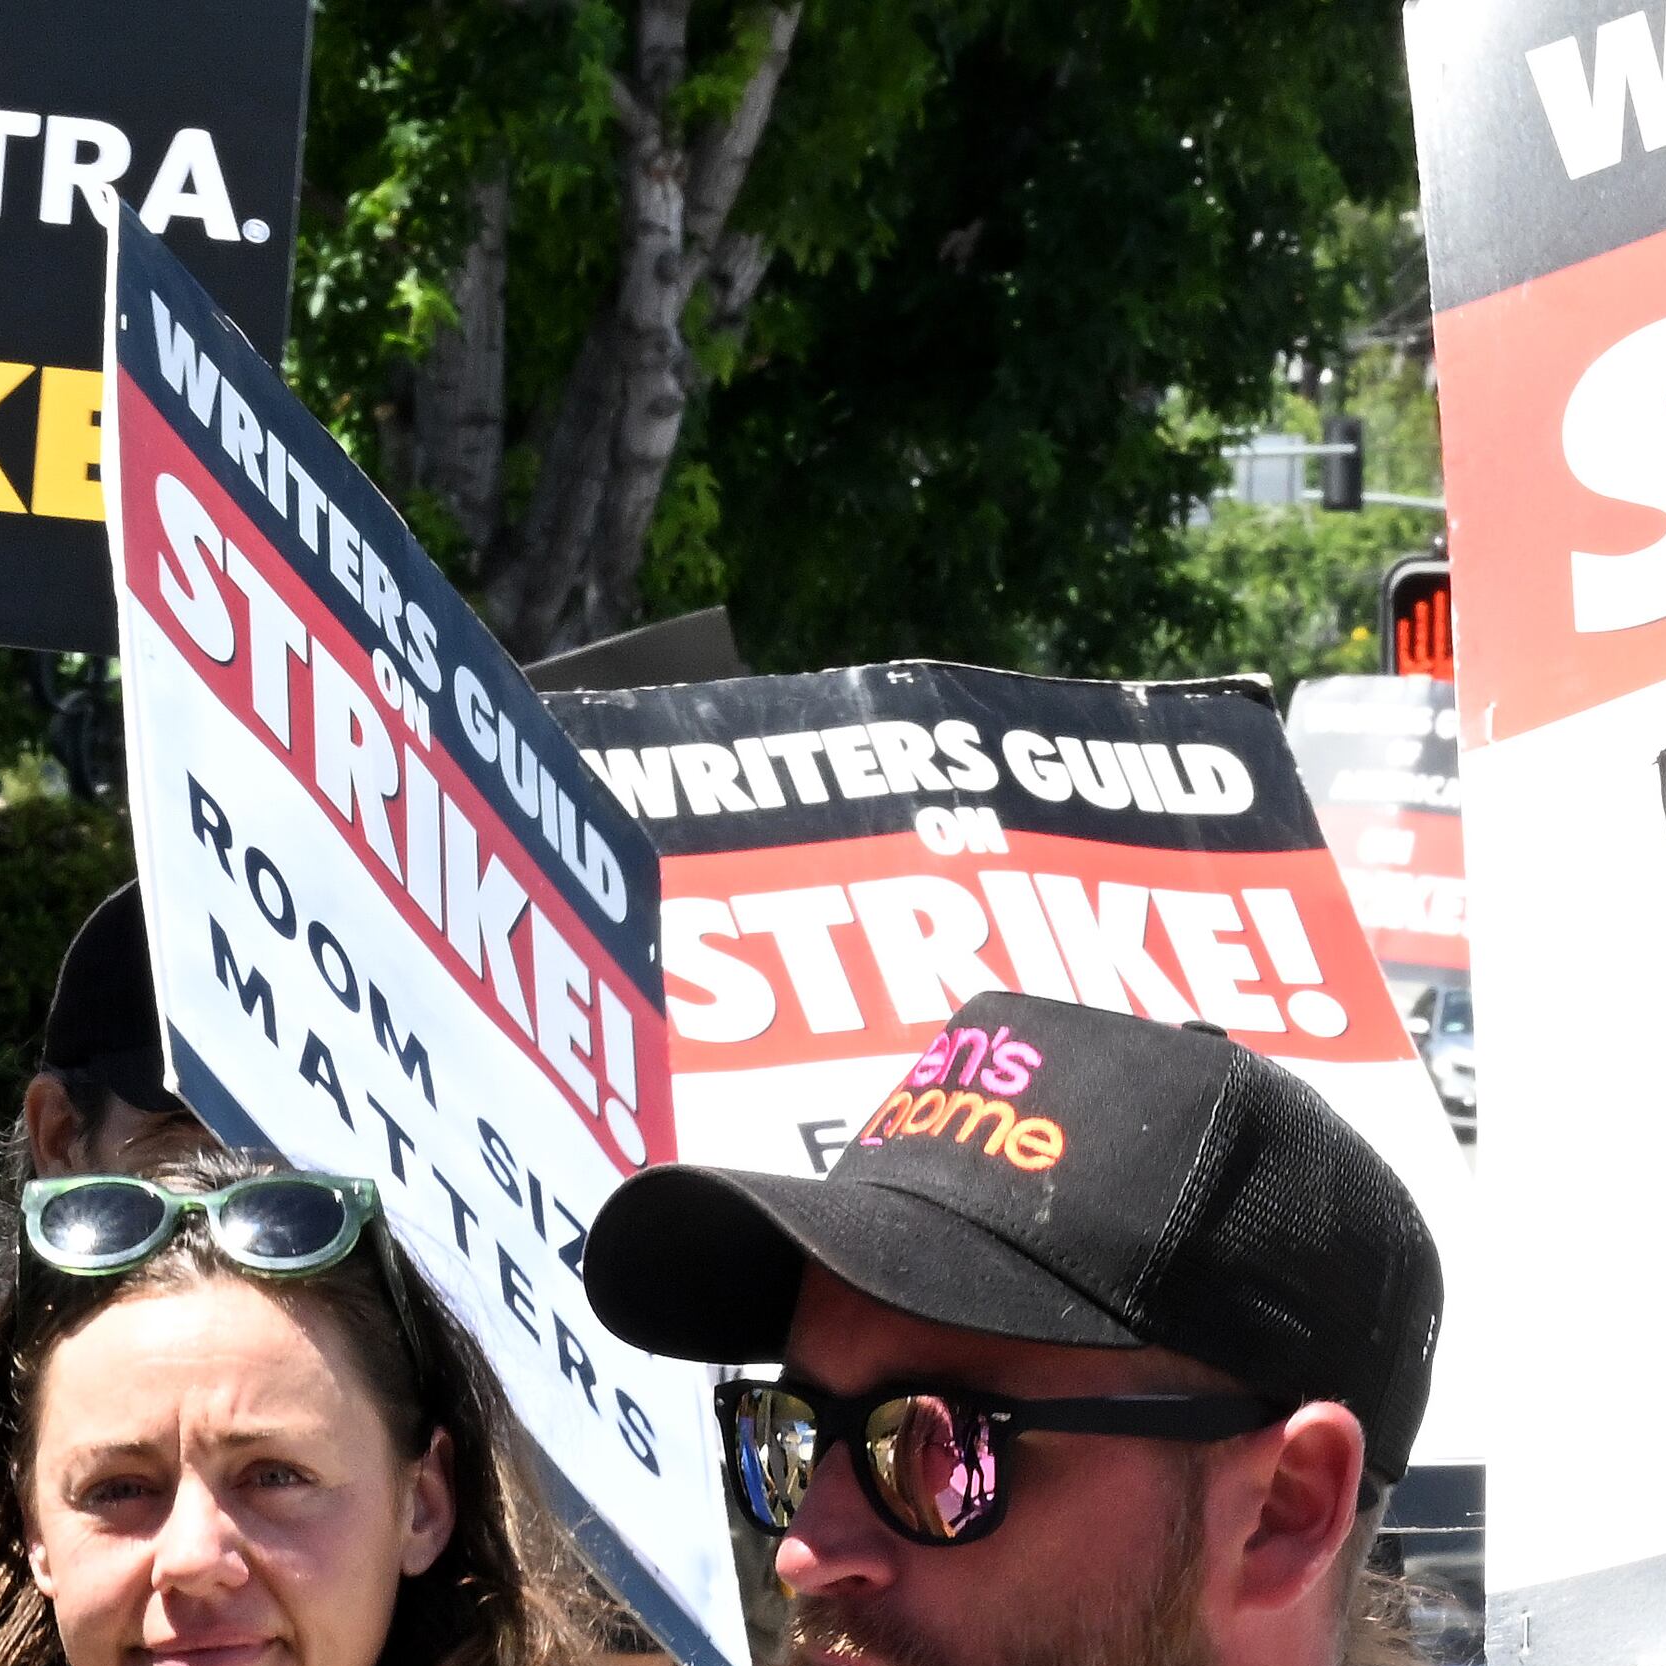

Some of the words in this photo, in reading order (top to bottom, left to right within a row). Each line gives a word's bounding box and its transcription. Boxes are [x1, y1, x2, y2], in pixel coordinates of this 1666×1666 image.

[150, 290, 443, 693] WRITERS
[453, 665, 626, 926] GUILD
[372, 648, 431, 752] ON
[584, 720, 997, 819] WRITERS
[1002, 730, 1254, 817] GUILD
[155, 472, 649, 1169] STRIKE!
[662, 869, 1349, 1045] STRIKE!
[916, 805, 1008, 857] ON
[186, 769, 438, 1113] ROOM
[476, 1116, 589, 1282] SIZ
[209, 913, 662, 1479] MATTERS
